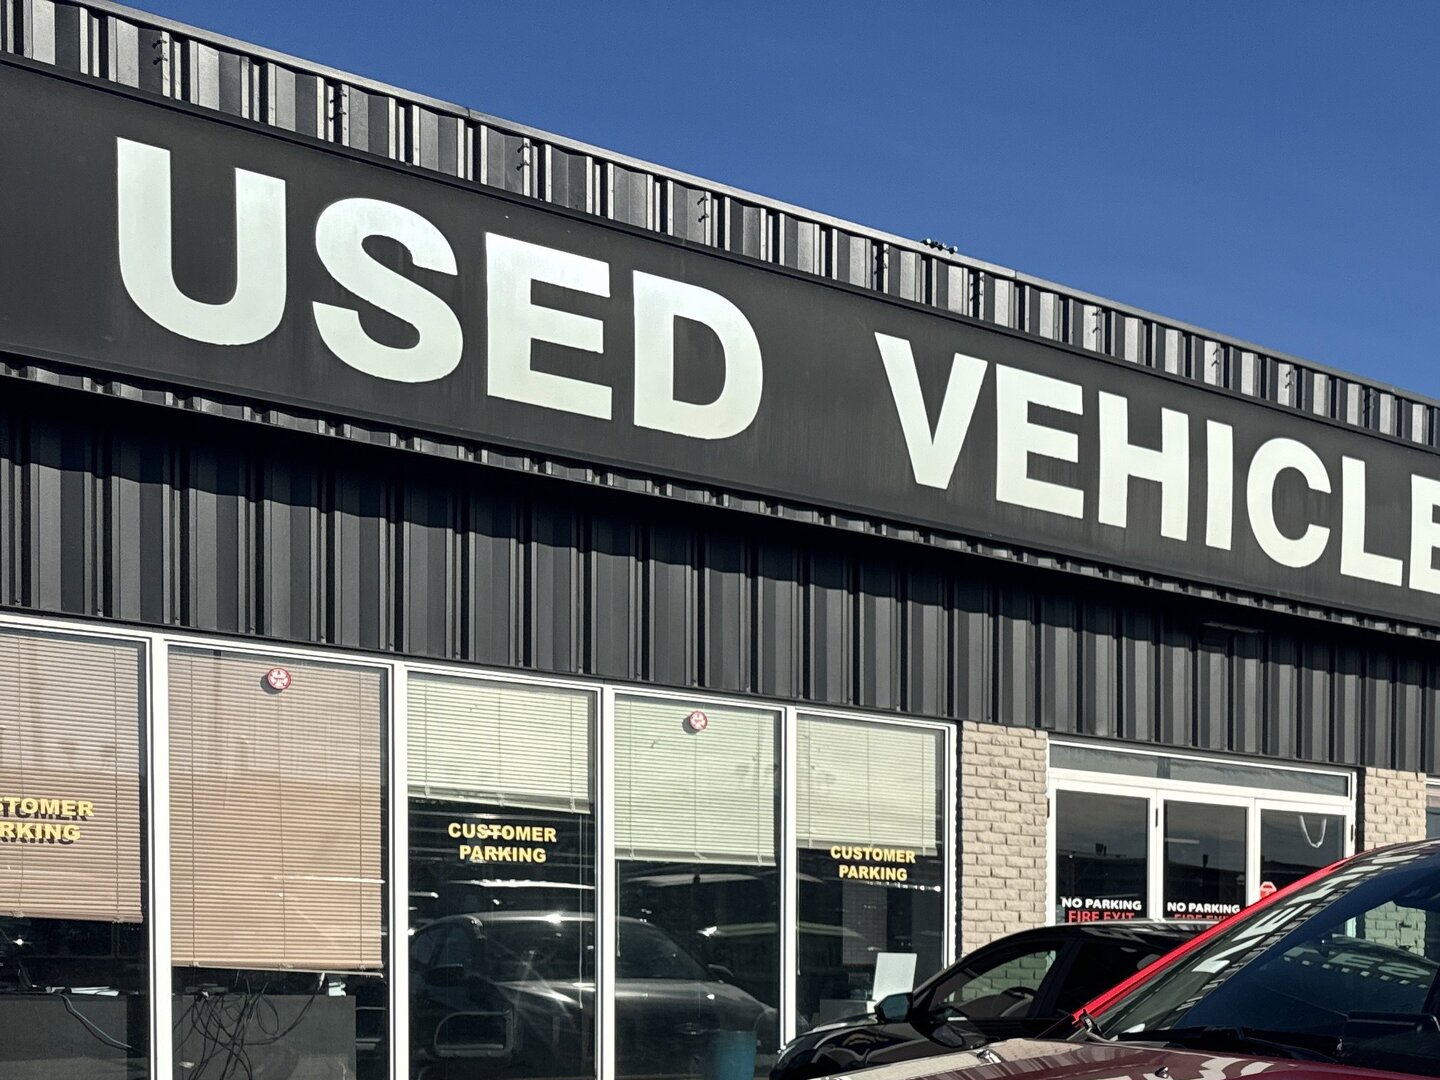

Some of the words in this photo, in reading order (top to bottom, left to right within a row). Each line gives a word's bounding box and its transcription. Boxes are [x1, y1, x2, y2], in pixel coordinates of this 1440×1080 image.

[116, 136, 763, 440] USED
[0, 796, 95, 817] TOMER
[447, 822, 558, 843] CUSTOMER
[459, 844, 547, 863] PARKING
[830, 845, 917, 864] CUSTOMER
[838, 864, 908, 882] PARKING
[1061, 897, 1083, 909] NO
[1085, 898, 1142, 911] PARKING
[1167, 901, 1185, 913] NO
[1190, 902, 1241, 914] PARKING
